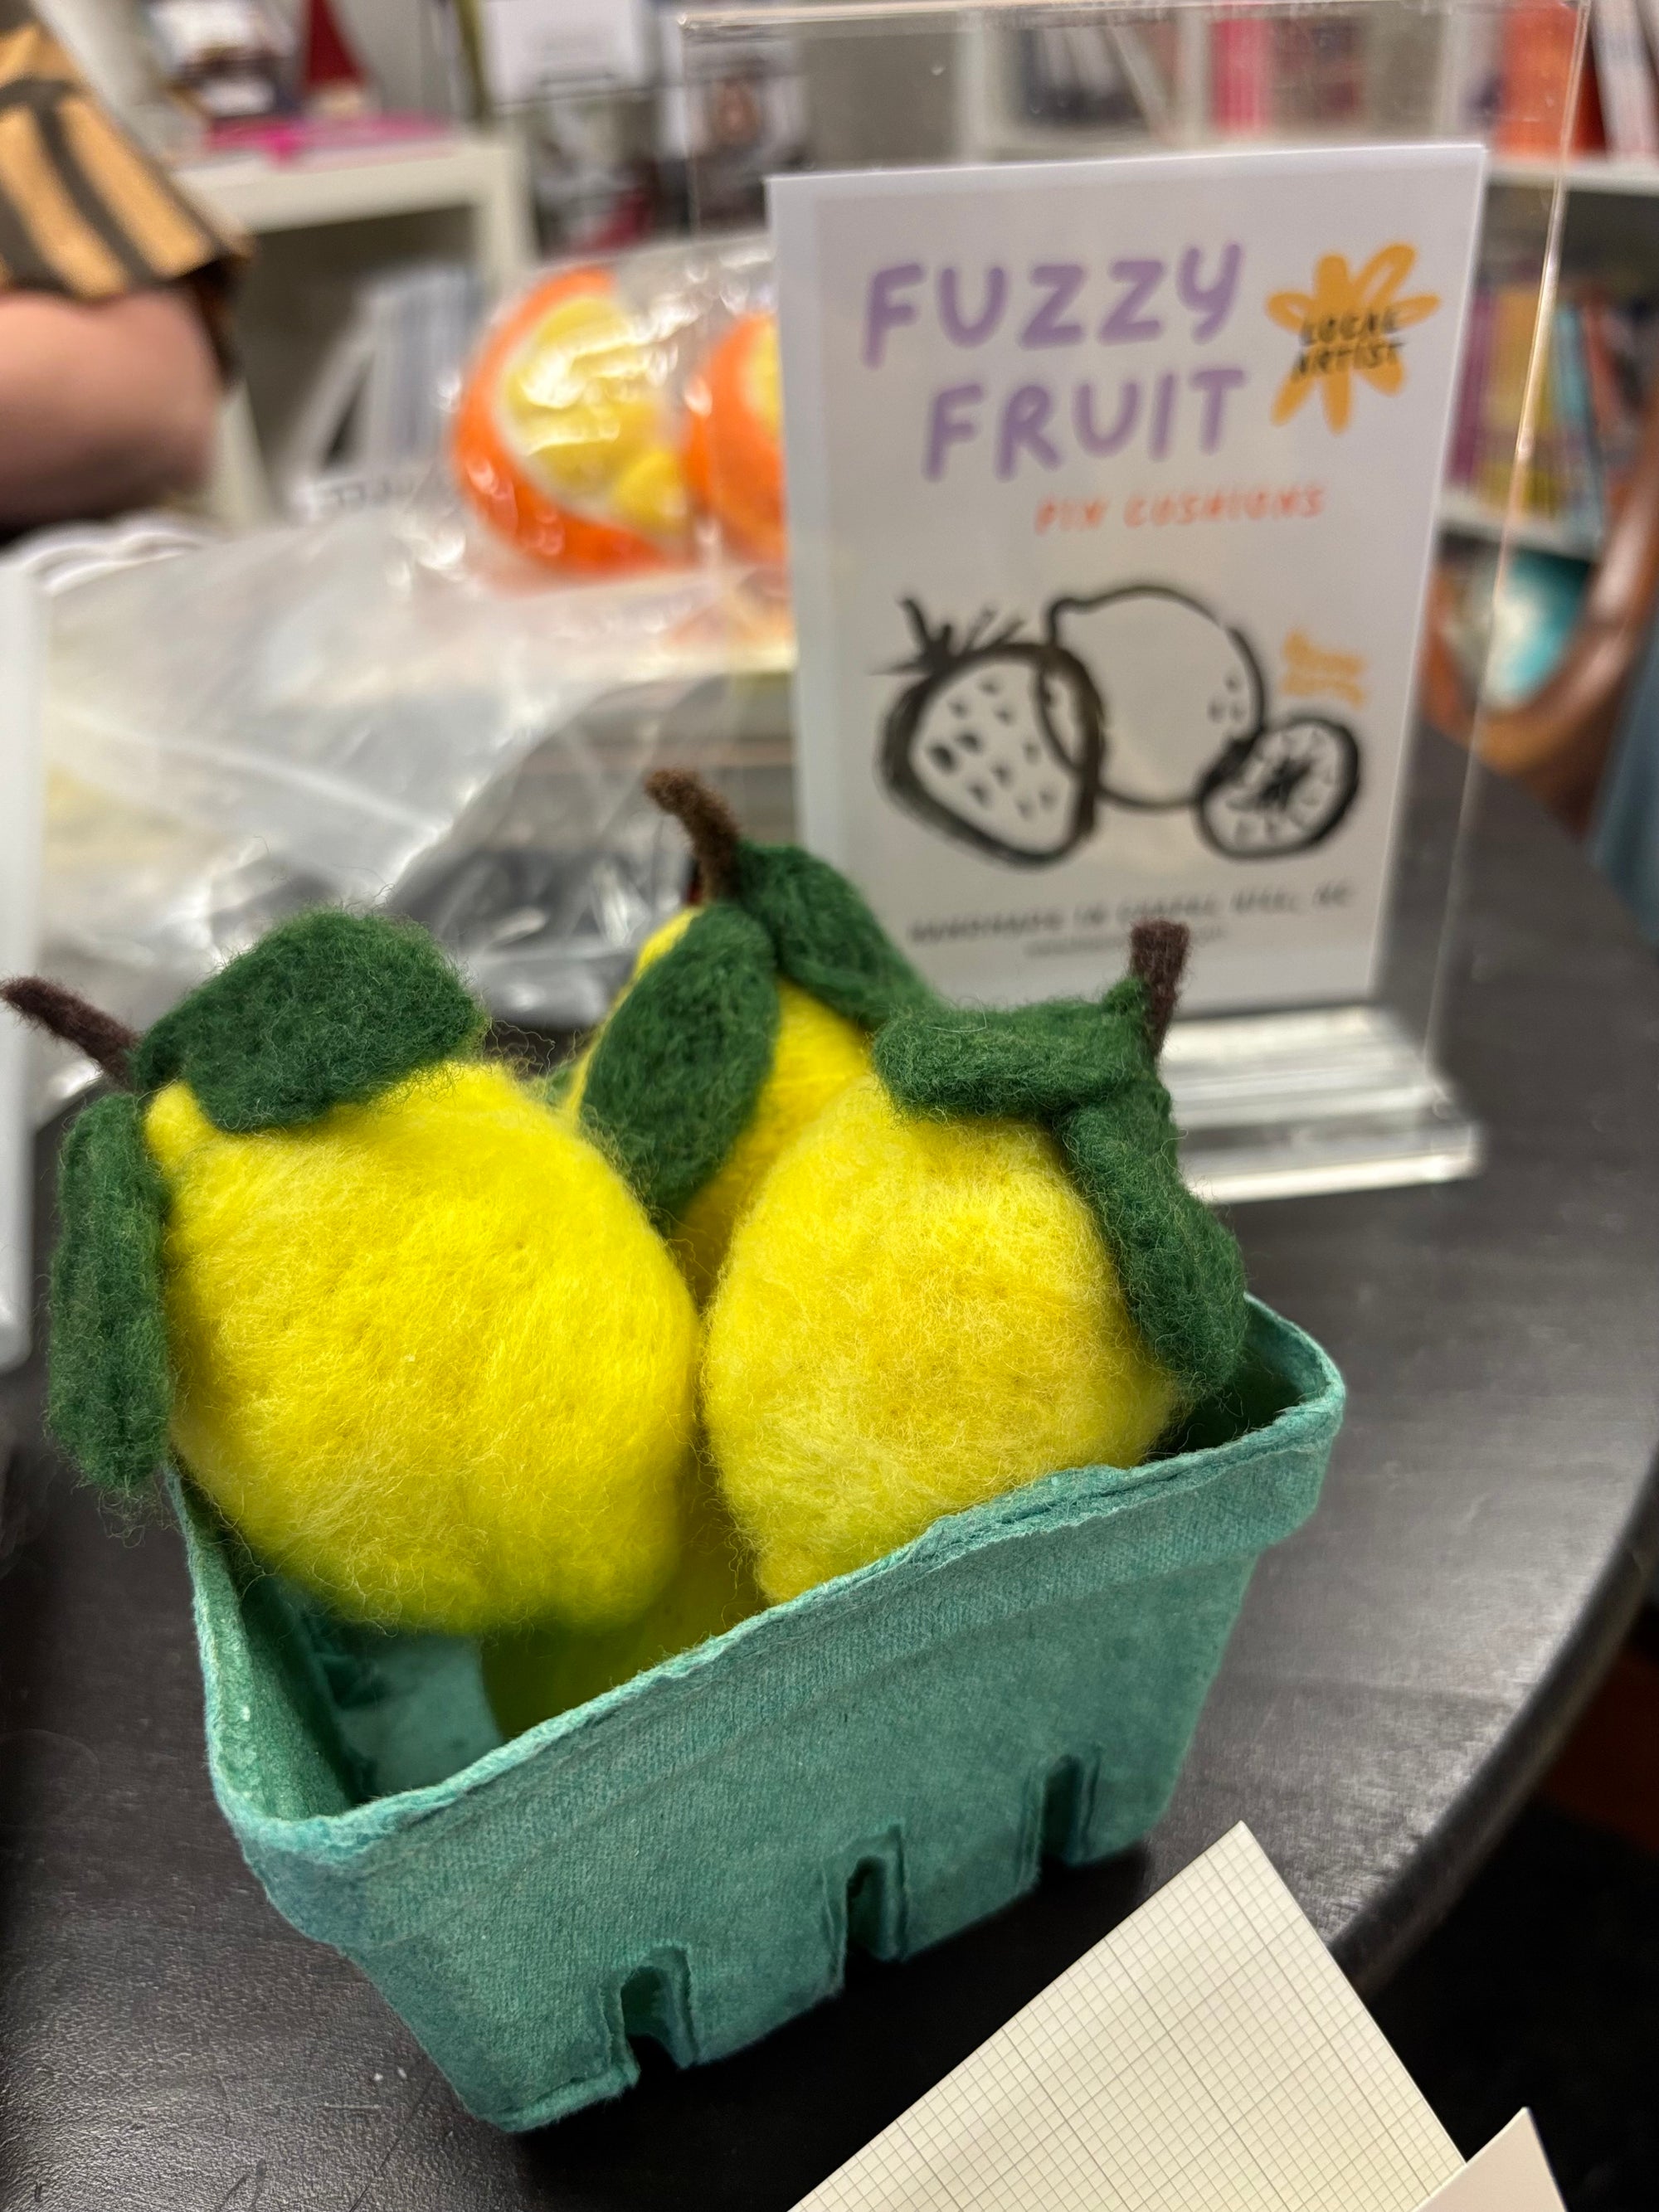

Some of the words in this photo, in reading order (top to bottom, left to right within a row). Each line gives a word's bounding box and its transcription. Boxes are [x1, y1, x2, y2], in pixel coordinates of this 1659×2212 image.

[863, 242, 1243, 370] FUZZY
[1299, 307, 1399, 346] LOCAL
[1291, 338, 1405, 381] ARTIST
[922, 365, 1248, 483] FRUIT
[1124, 480, 1326, 528] CUSHIONS
